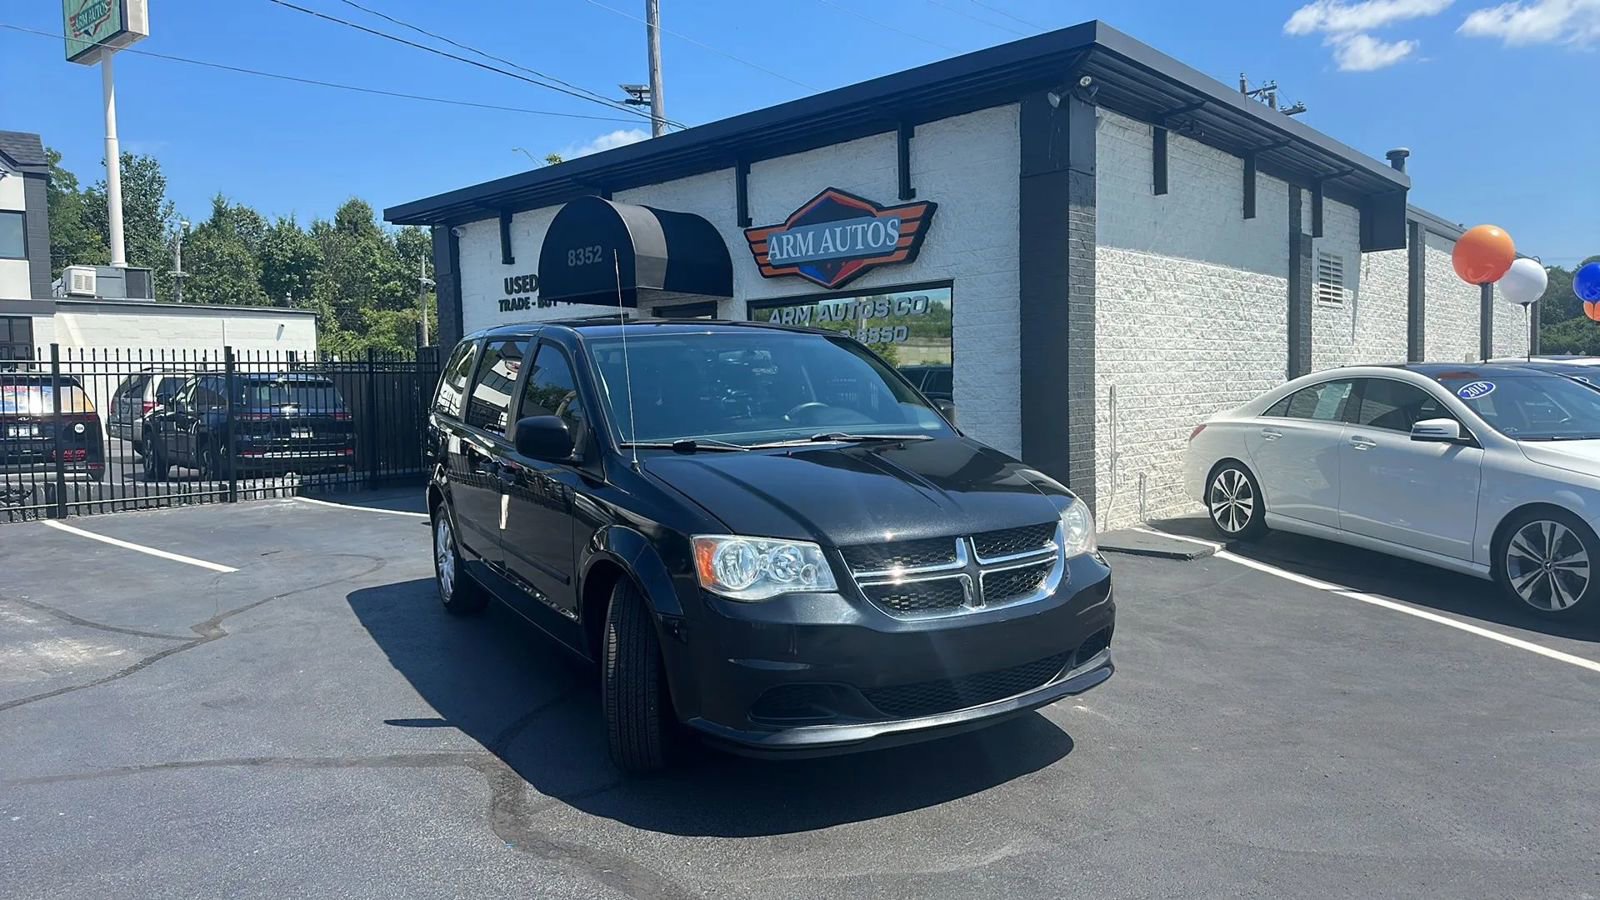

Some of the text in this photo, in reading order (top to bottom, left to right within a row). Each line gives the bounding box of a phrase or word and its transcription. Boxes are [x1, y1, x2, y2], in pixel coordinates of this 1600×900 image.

[766, 218, 900, 261] ARM AUTOS
[567, 245, 603, 267] 8352
[503, 274, 539, 295] USED
[498, 296, 531, 312] TRADE
[769, 305, 814, 326] ARM
[817, 300, 891, 323] AUTOS
[1463, 381, 1489, 398] 2019
